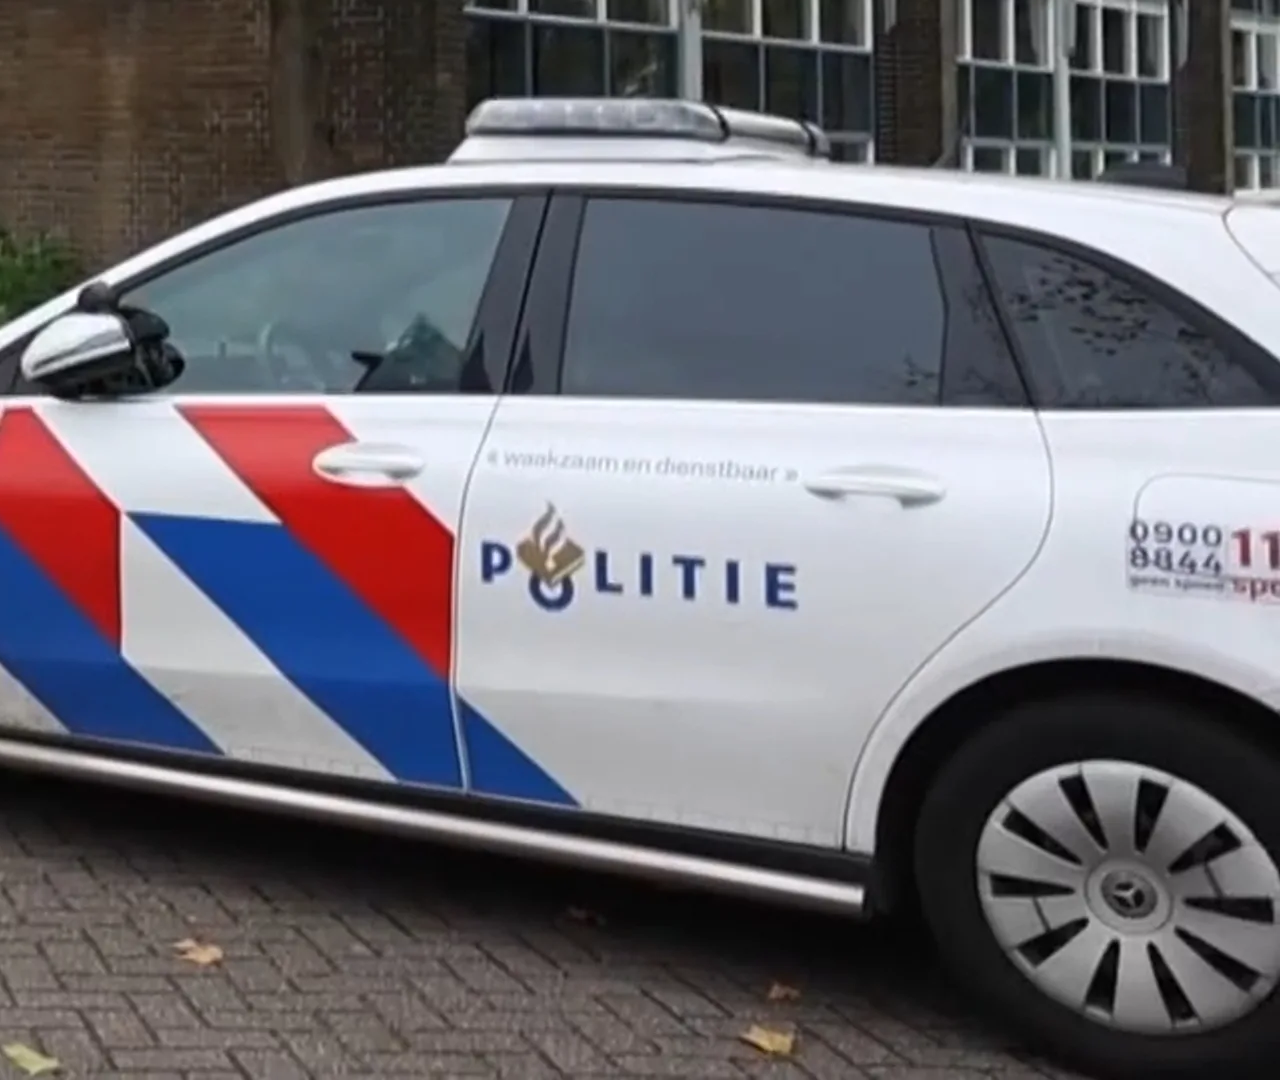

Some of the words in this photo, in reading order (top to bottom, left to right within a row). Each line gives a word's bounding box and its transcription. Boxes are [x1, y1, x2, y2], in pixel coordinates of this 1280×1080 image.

[503, 450, 619, 472] waakzaam
[655, 456, 780, 483] dienstbaar
[1130, 520, 1223, 548] 0900
[481, 538, 798, 611] POLITIE
[1130, 546, 1223, 576] 8844
